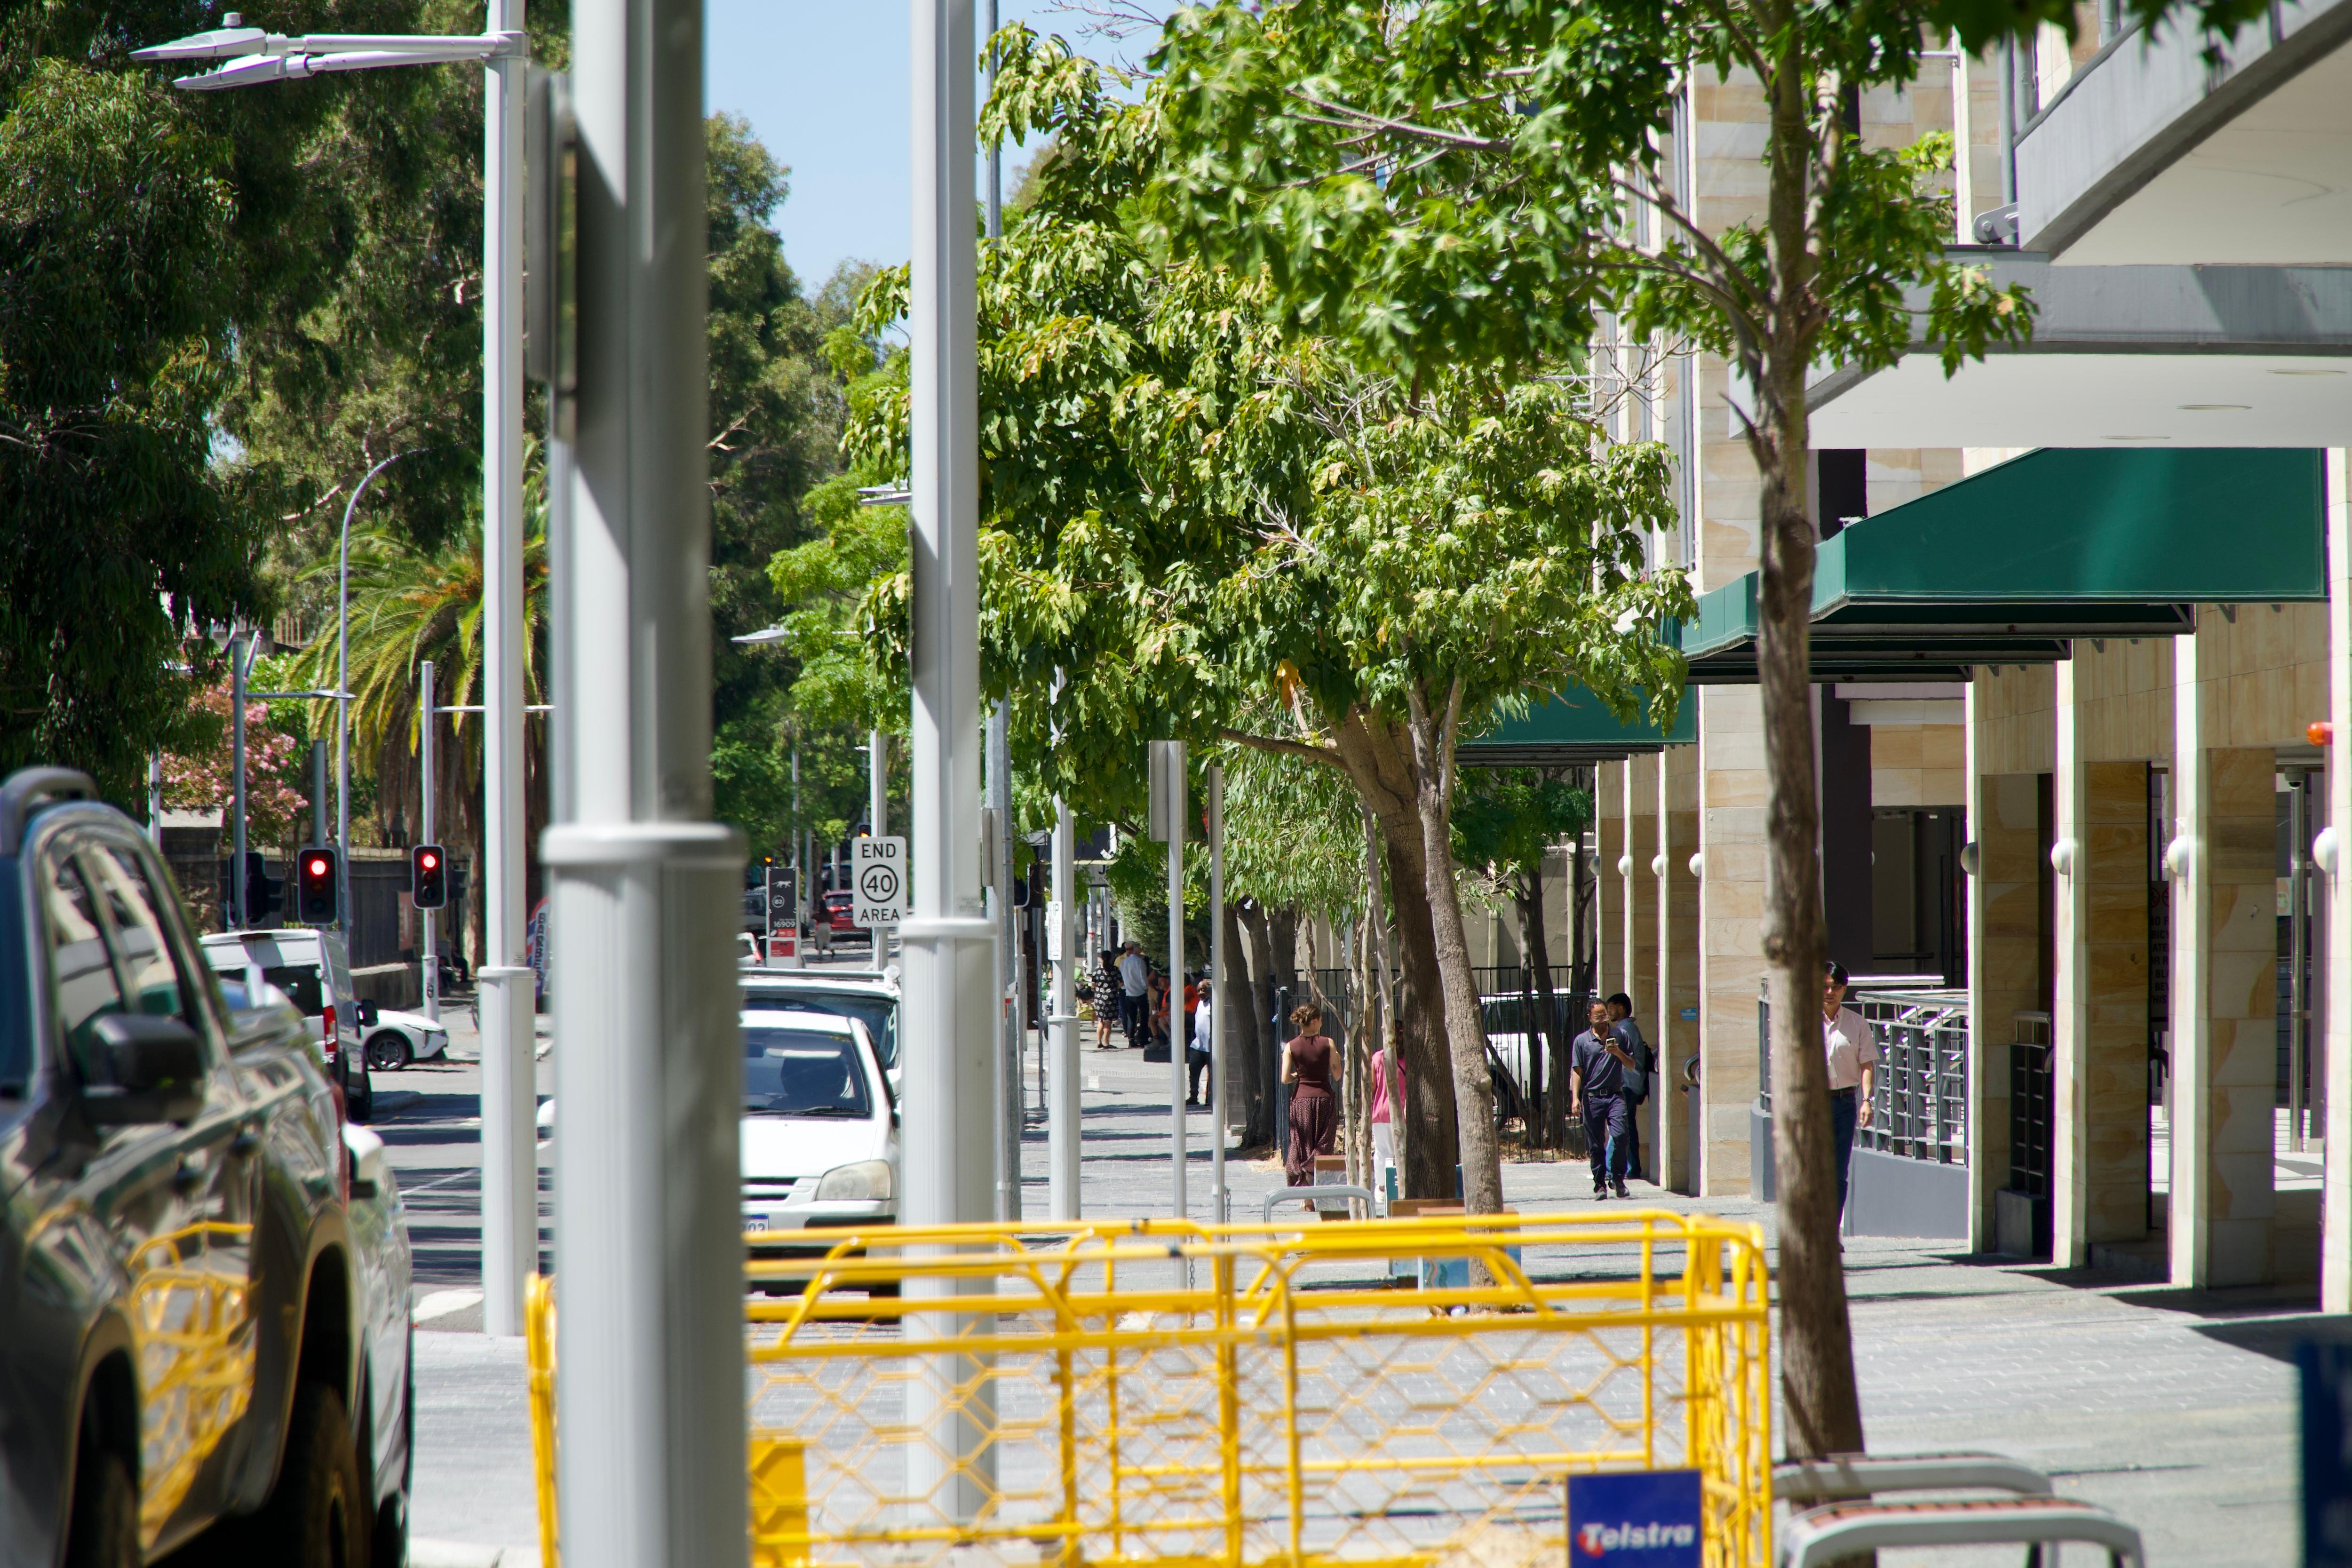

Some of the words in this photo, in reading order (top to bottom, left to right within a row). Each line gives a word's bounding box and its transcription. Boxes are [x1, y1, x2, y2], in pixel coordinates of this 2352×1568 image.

[862, 844, 896, 858] END
[866, 875, 892, 892] 40
[860, 908, 899, 922] AREA
[1581, 1521, 1695, 1552] Telstra
